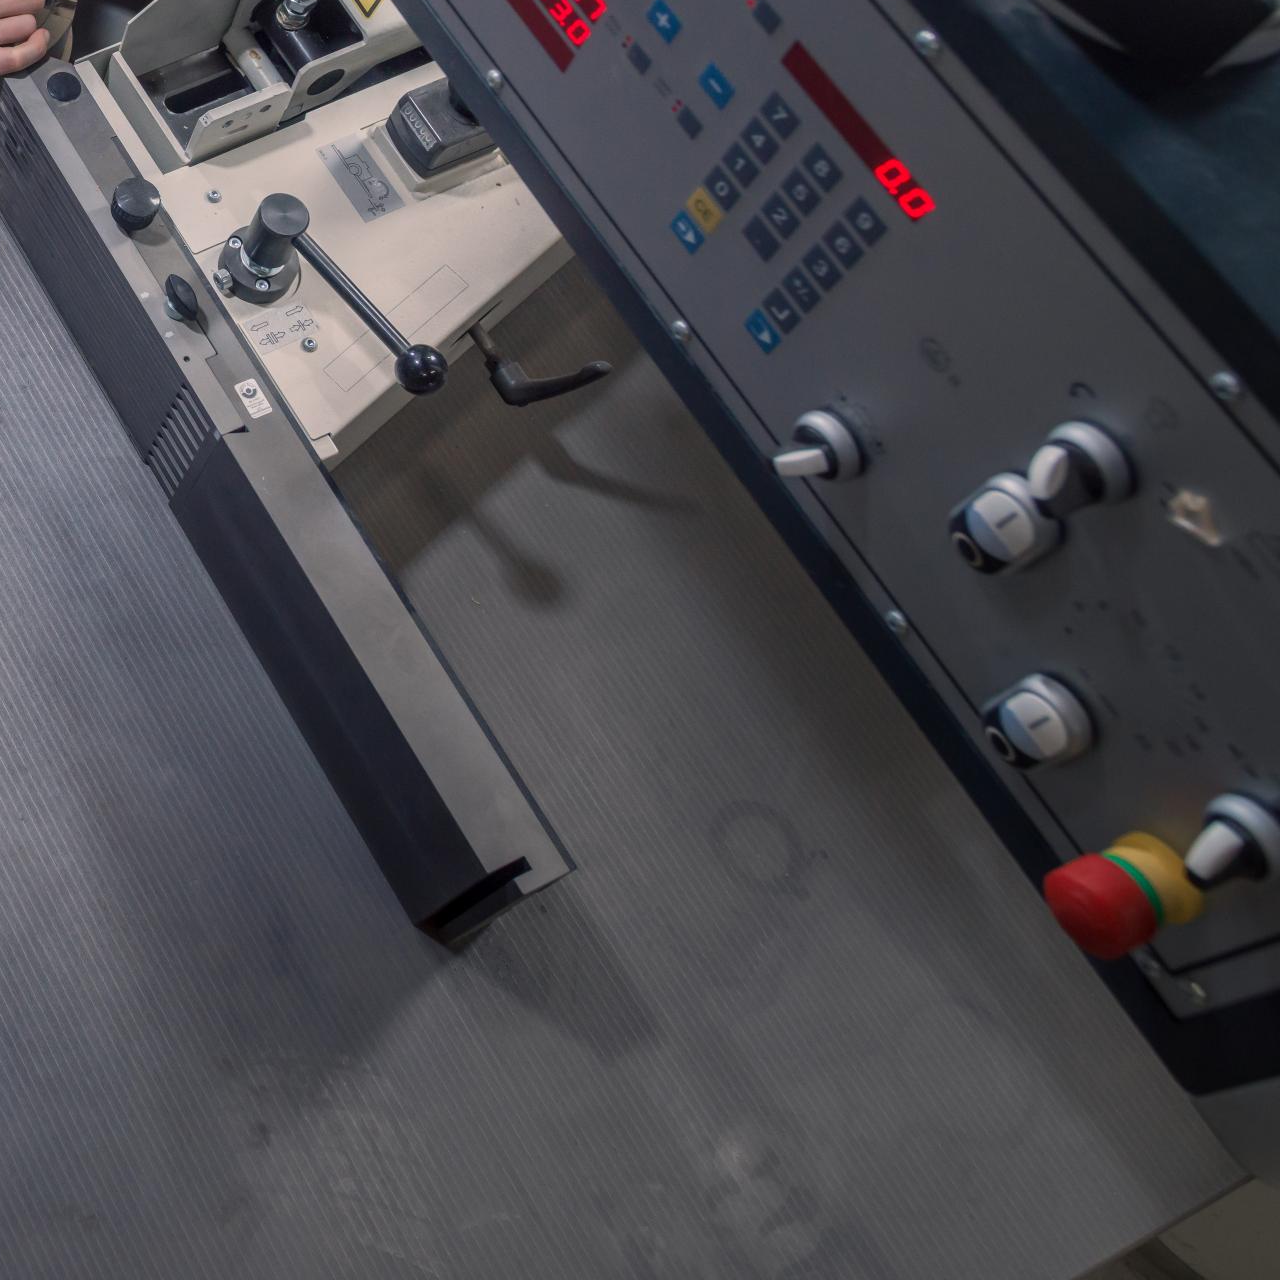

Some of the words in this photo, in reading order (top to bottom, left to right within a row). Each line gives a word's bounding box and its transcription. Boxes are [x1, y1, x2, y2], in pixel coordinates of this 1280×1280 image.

[771, 106, 789, 122] 7
[751, 132, 766, 149] 4
[874, 158, 935, 221] 0.0
[771, 208, 789, 226] 2
